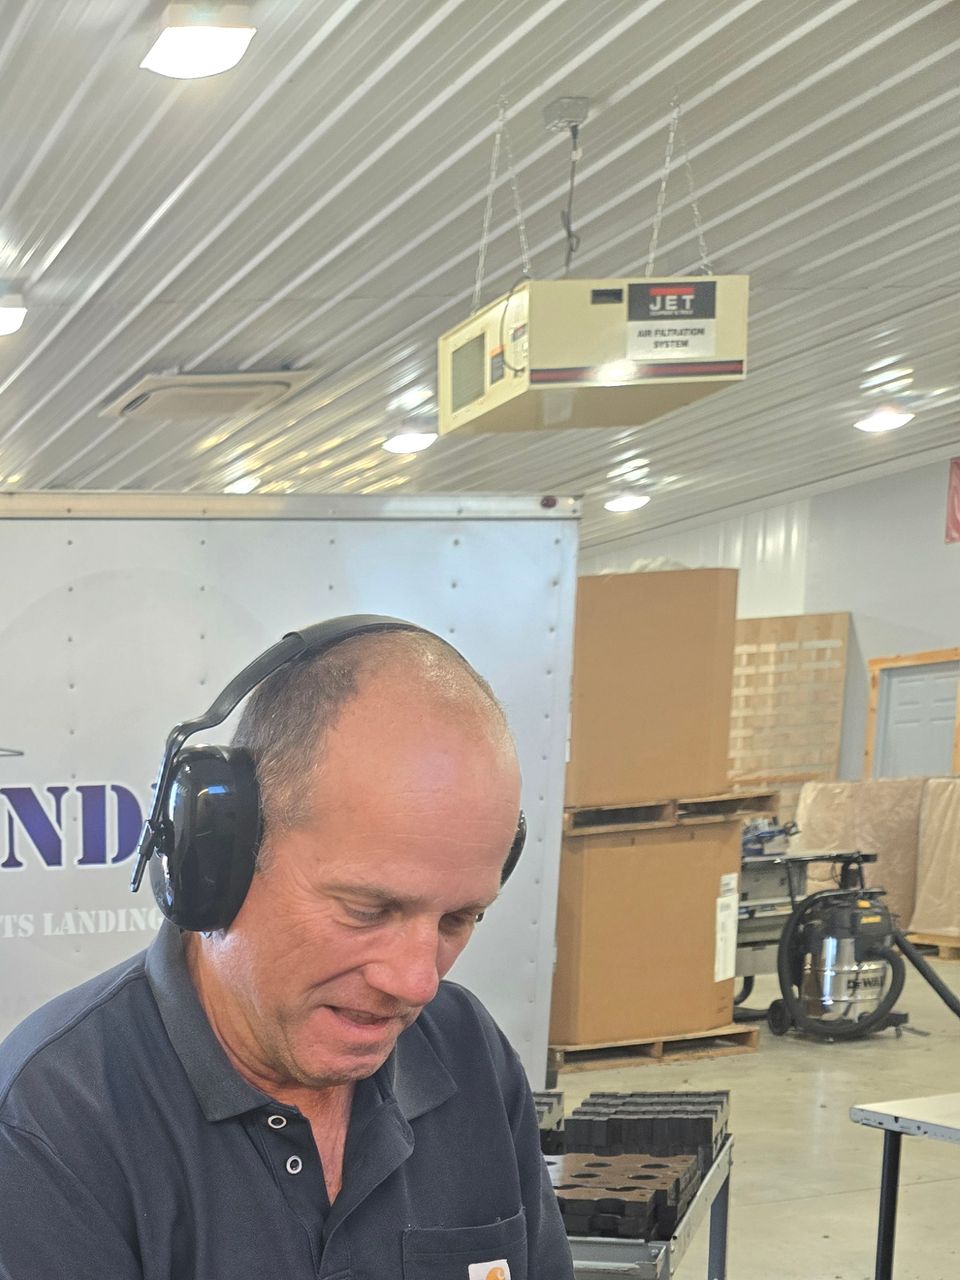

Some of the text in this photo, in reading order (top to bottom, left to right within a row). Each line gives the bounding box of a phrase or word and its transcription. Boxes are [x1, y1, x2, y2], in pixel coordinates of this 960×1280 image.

[648, 295, 695, 311] JET
[637, 327, 706, 338] AIR FILTRATION
[653, 340, 689, 349] SYSTEM
[43, 907, 162, 936] LANDING
